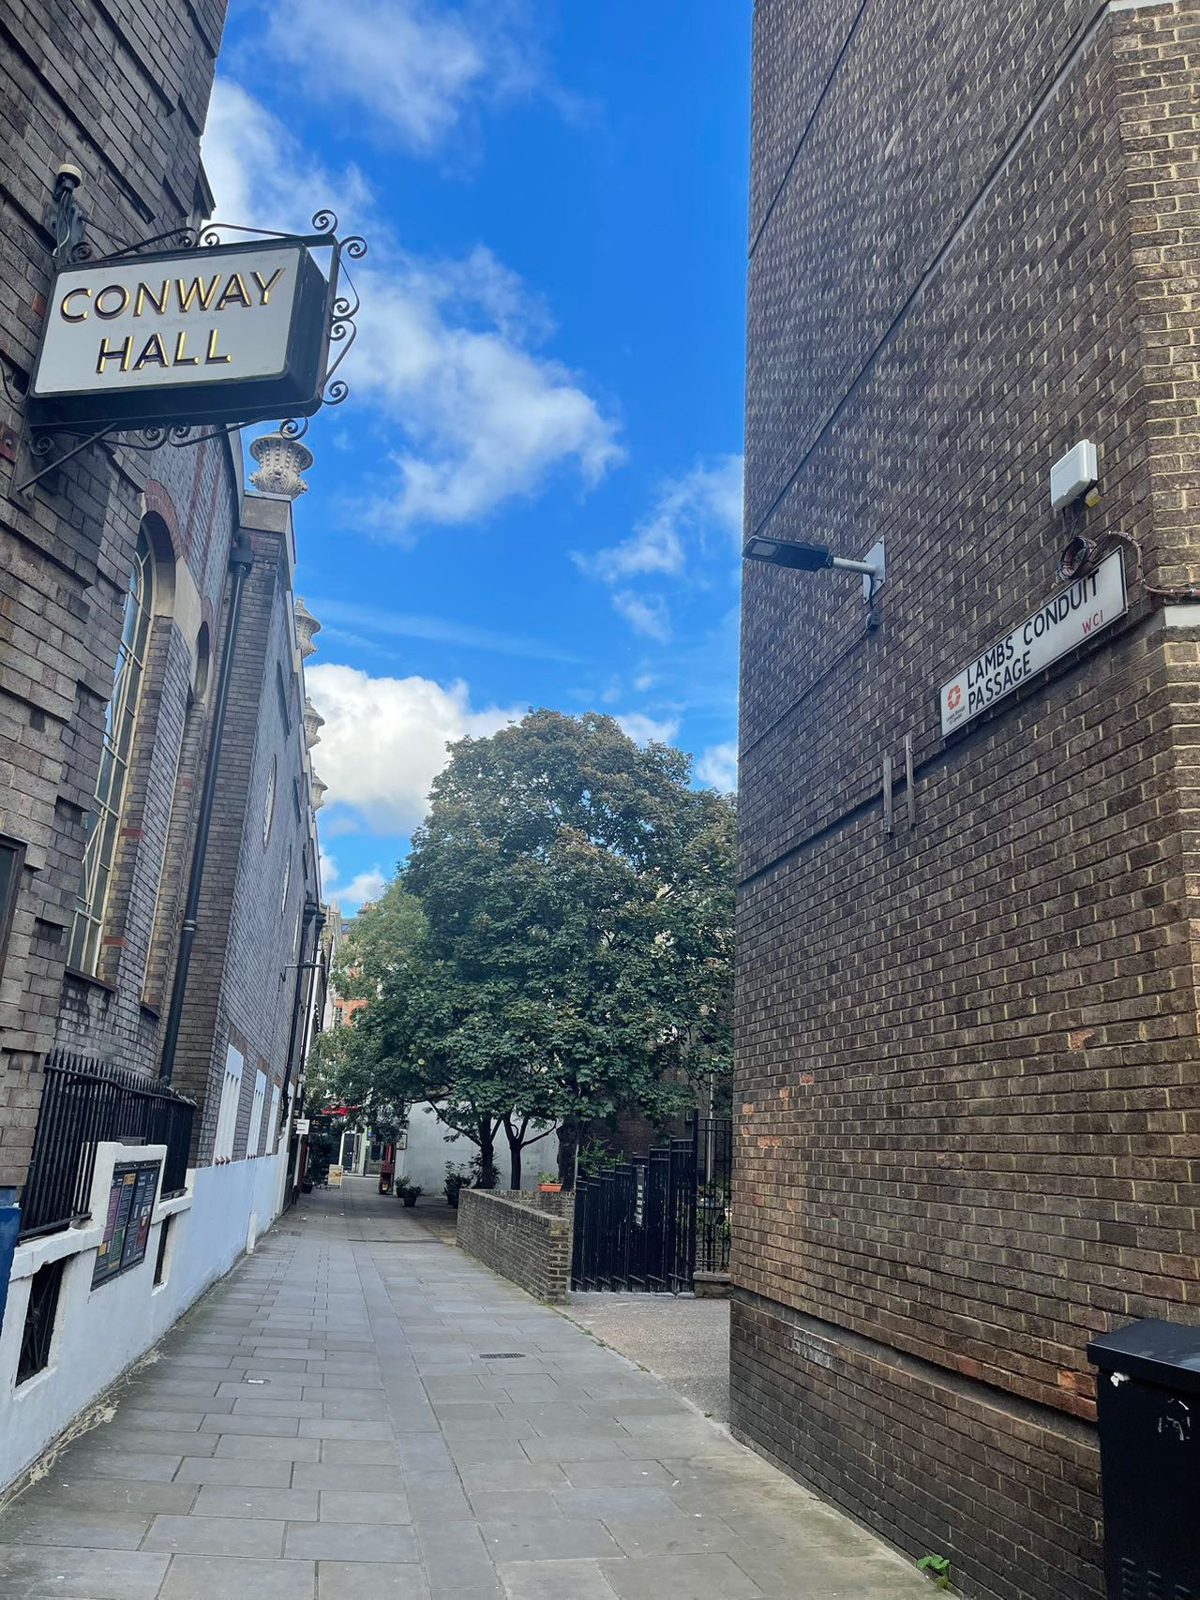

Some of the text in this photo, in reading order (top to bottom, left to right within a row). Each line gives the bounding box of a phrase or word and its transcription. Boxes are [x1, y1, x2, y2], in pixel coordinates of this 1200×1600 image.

[60, 268, 286, 323] CONWAY
[96, 328, 232, 374] HALL
[967, 568, 1100, 690] LAMBS CONDUIT
[967, 650, 1032, 714] PASSAGE
